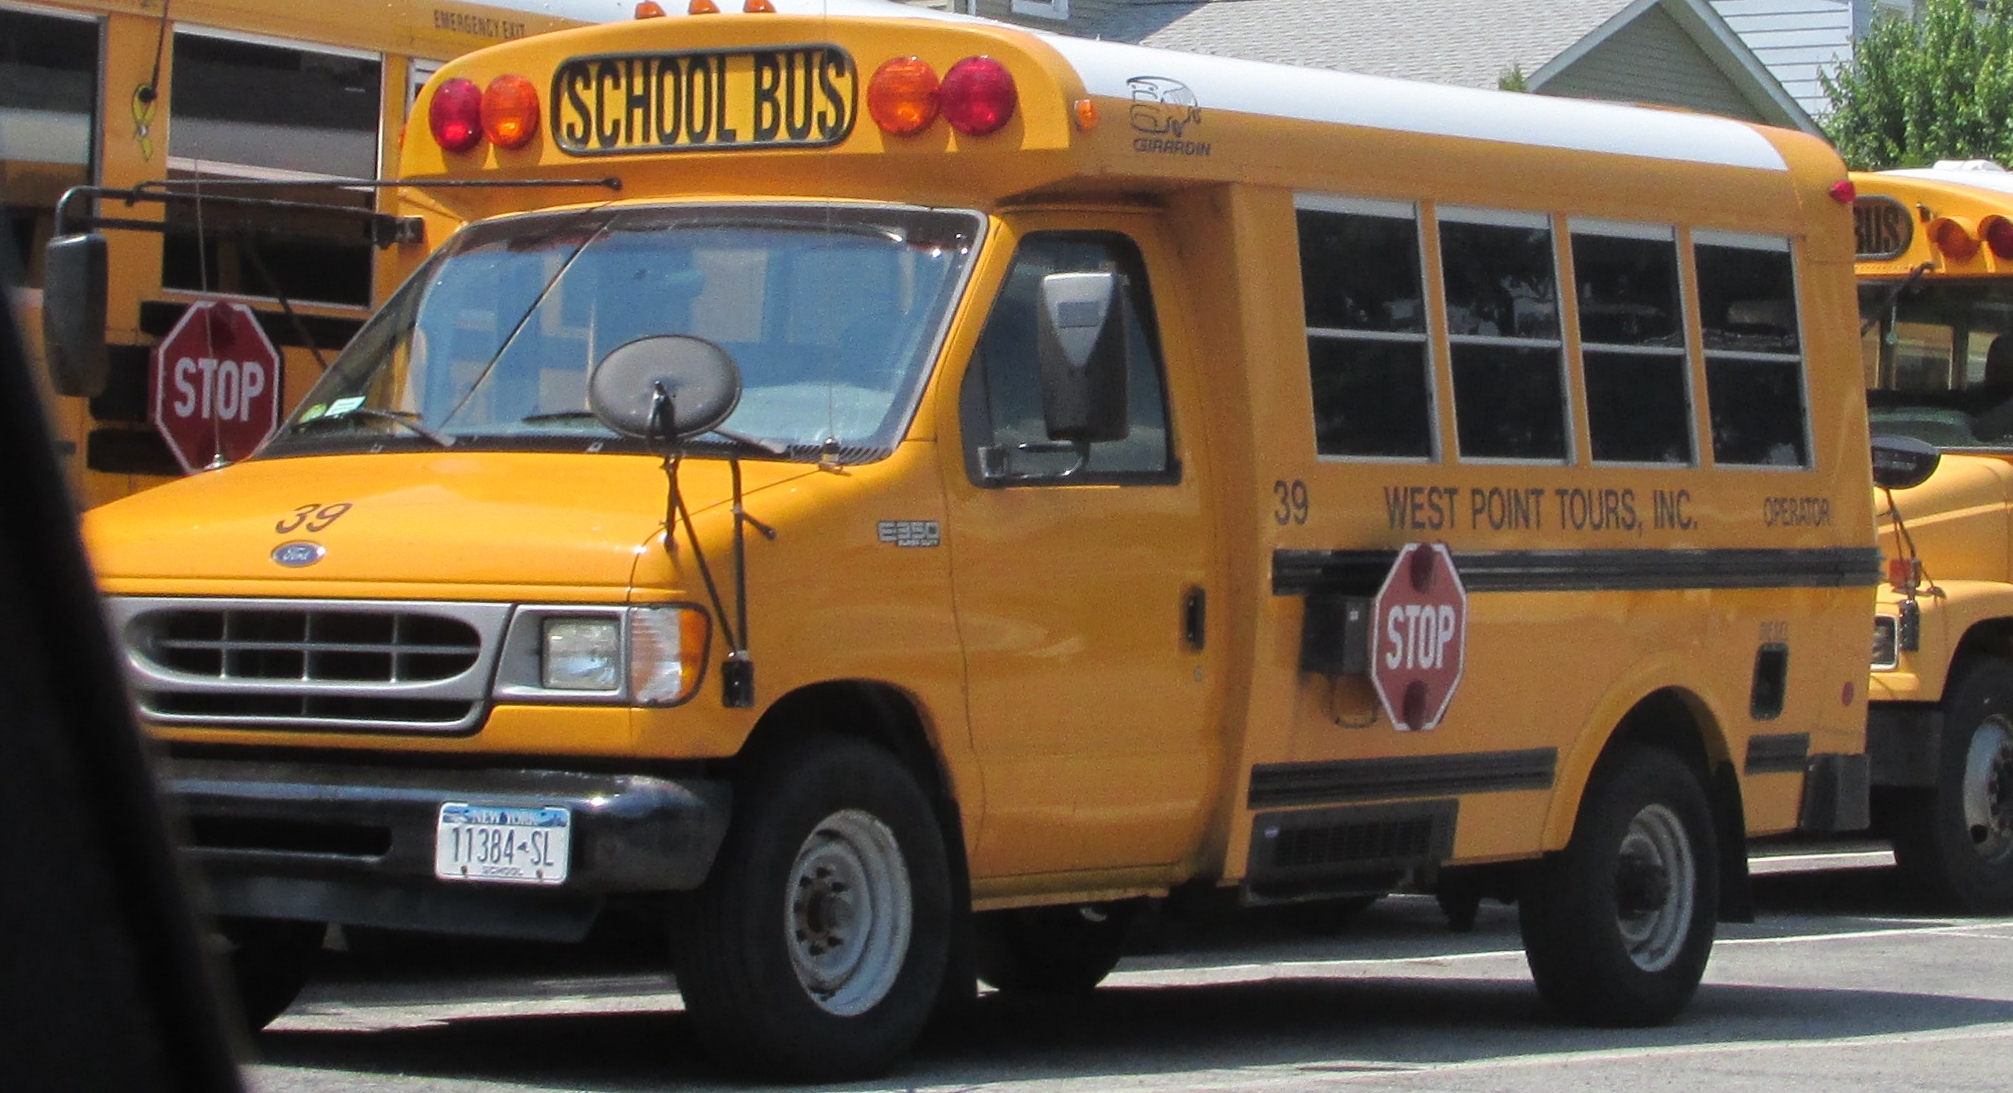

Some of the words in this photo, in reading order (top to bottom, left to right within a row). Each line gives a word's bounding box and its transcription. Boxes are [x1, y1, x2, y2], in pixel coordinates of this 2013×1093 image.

[434, 9, 499, 37] EMERGENCY
[502, 21, 525, 39] EXIT
[566, 54, 737, 149] SCHOOL
[754, 47, 846, 142] BUS
[1133, 137, 1211, 156] GIRARDIN
[174, 356, 266, 422] STOP
[275, 502, 353, 534] 39
[1273, 480, 1308, 526] 39
[1384, 486, 1459, 530] WEST
[1470, 487, 1545, 530] POINT
[1555, 488, 1643, 537] TOURS,
[1653, 489, 1699, 530] INC.
[1763, 496, 1830, 527] OPERATOR
[1385, 604, 1456, 670] STOP
[452, 826, 515, 865] 11384
[530, 829, 555, 867] SL
[482, 865, 524, 876] SCHOOL
